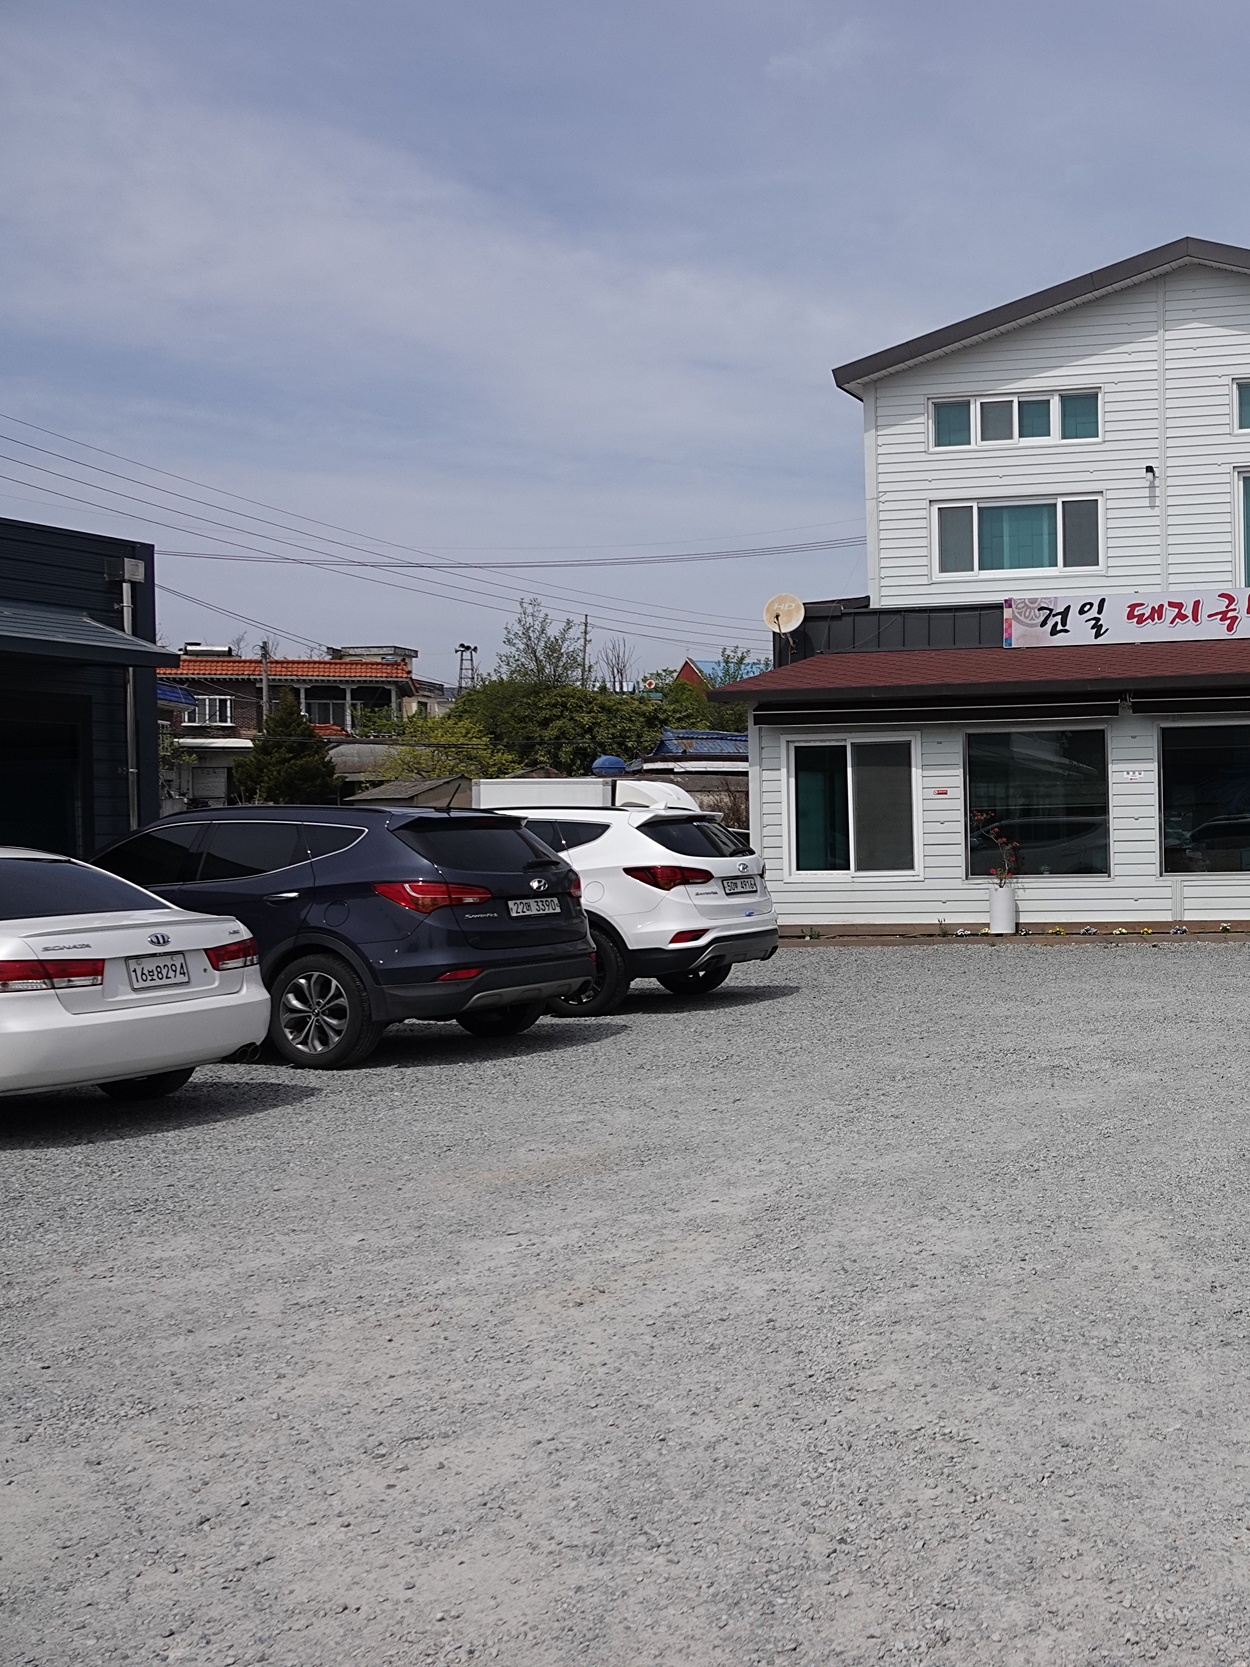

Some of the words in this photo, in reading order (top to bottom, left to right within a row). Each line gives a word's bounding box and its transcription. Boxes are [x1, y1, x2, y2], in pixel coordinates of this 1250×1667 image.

[773, 602, 796, 610] HD
[534, 899, 557, 912] 3390
[132, 962, 186, 983] 16보8294
